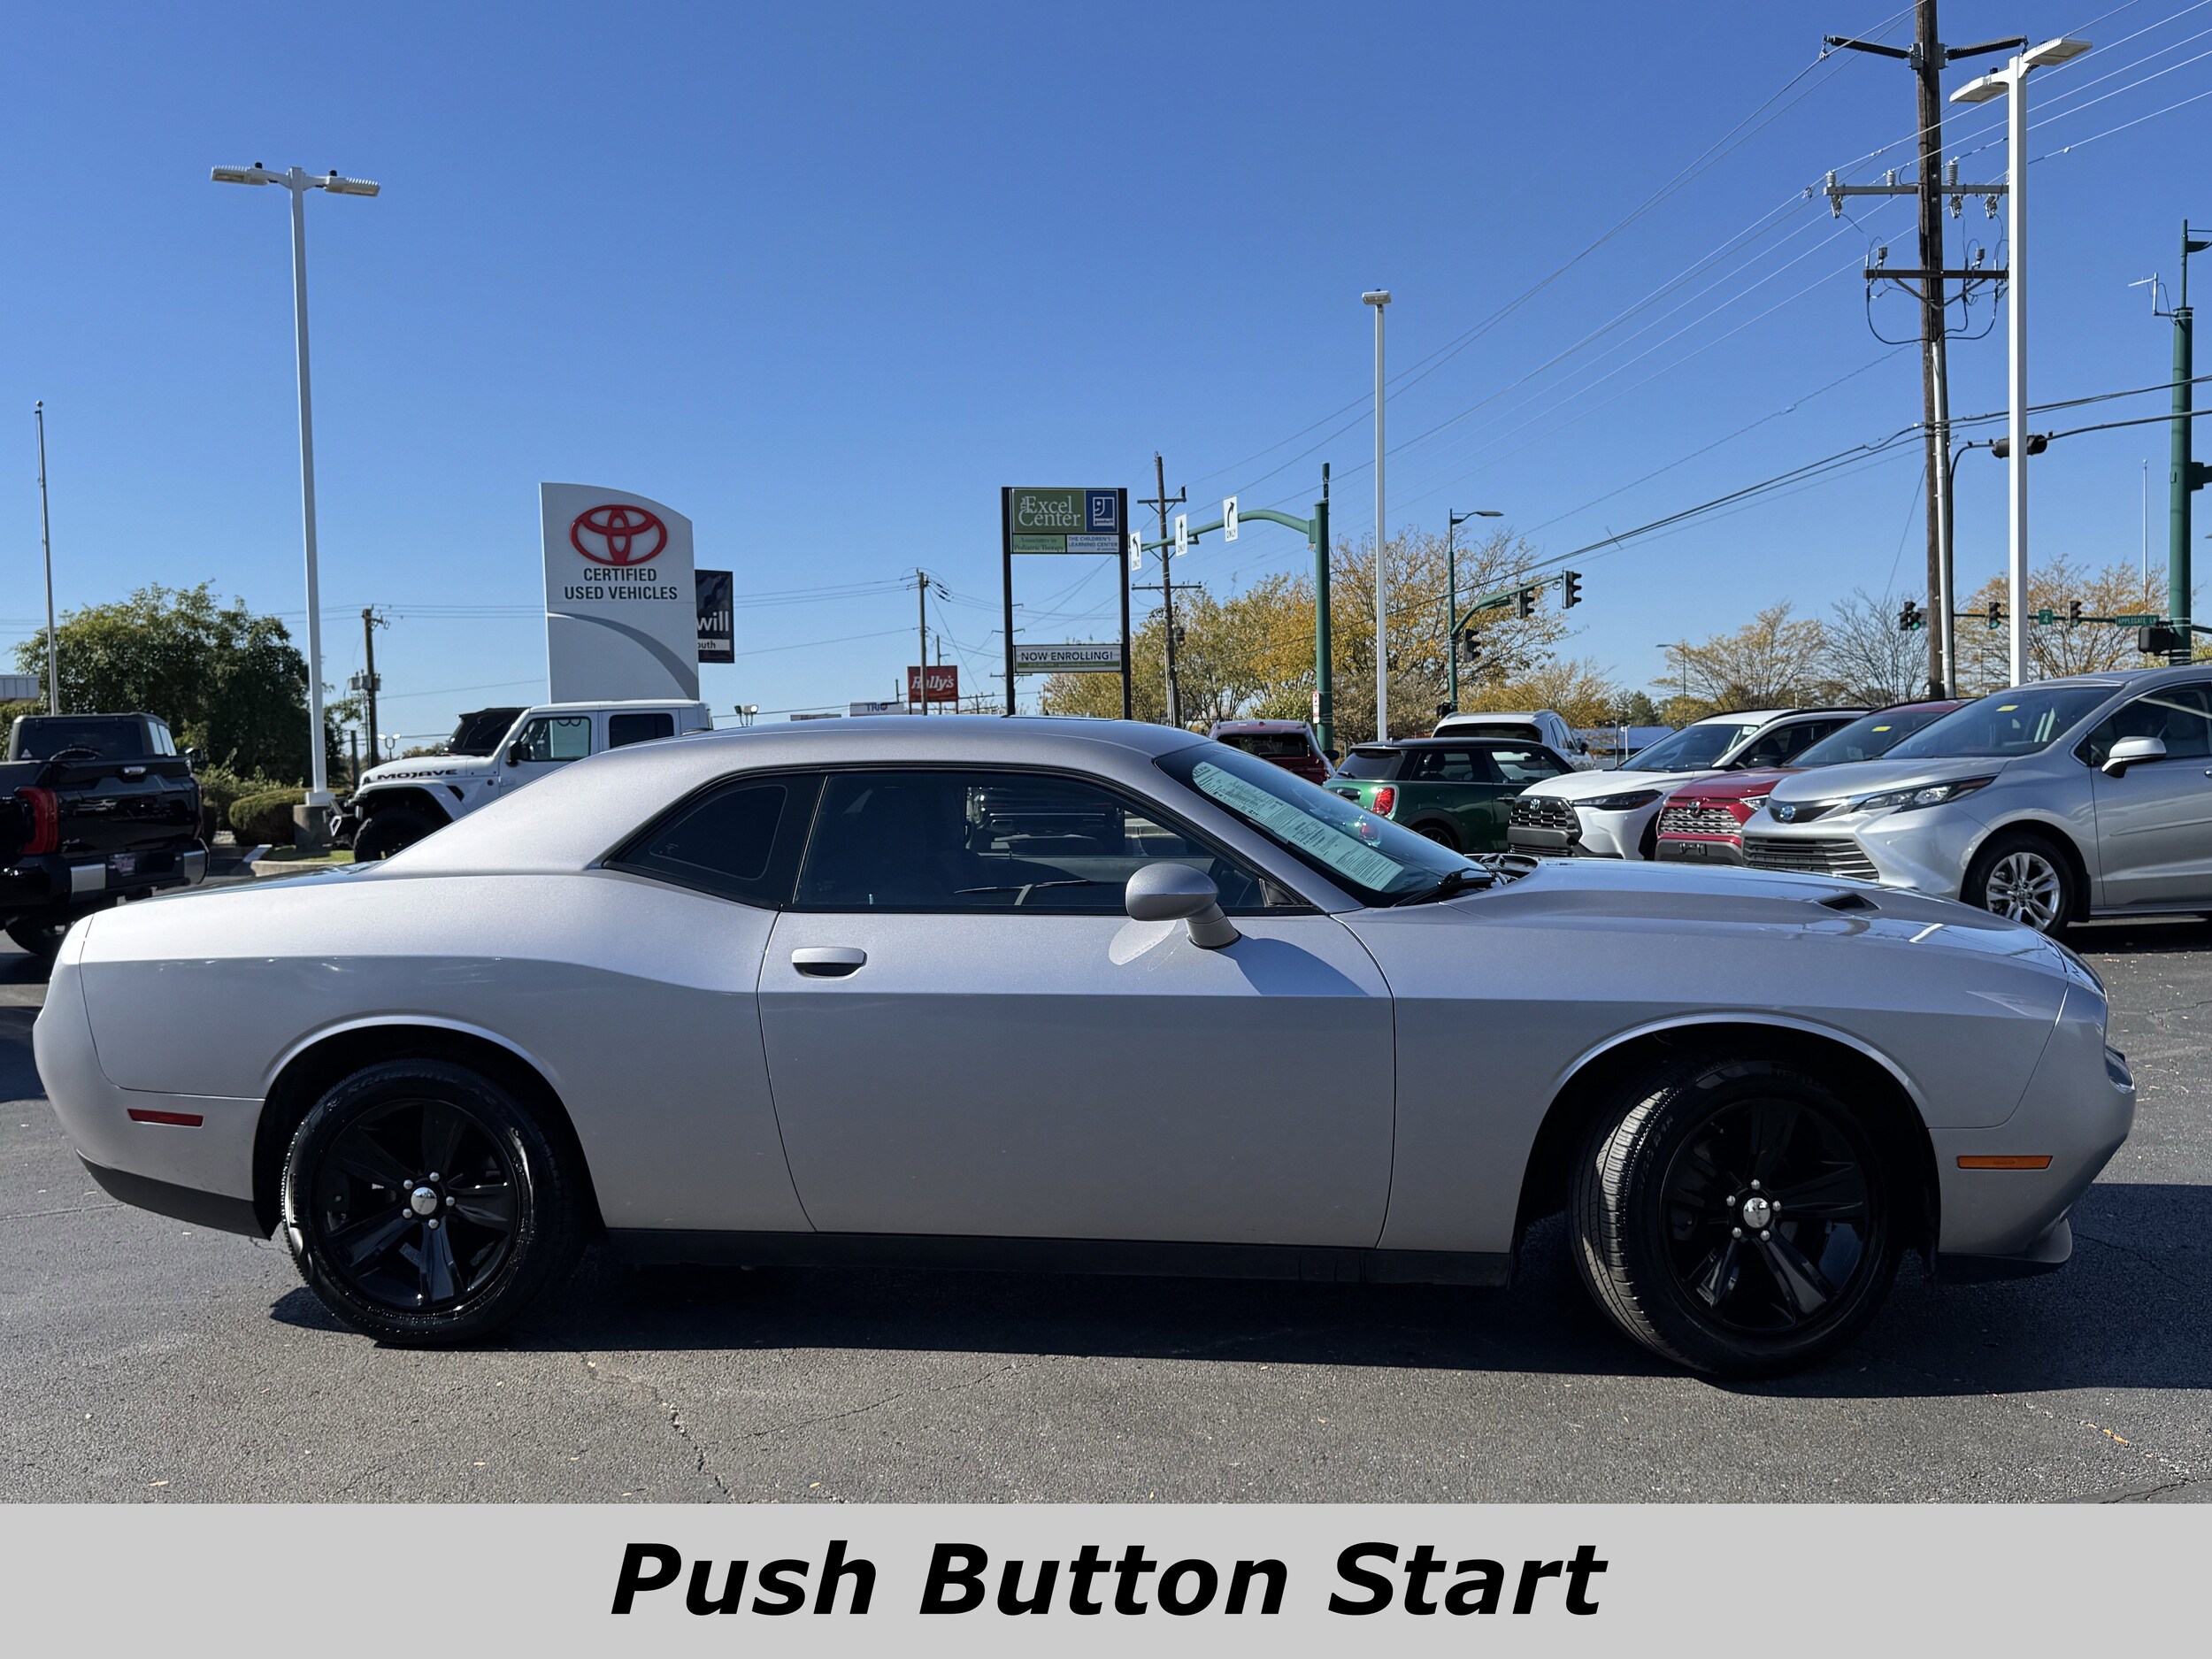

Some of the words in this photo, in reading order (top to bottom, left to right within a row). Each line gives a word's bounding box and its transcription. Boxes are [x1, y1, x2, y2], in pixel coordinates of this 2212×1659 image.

[1025, 495, 1073, 514] Excel
[1018, 509, 1080, 526] Center
[584, 568, 657, 582] CERTIFIED
[565, 587, 603, 600] USED
[609, 587, 678, 601] VEHICLES
[1021, 652, 1048, 661] NOW
[1050, 651, 1113, 662] ENROLLING!
[377, 769, 458, 780] MOJAVE
